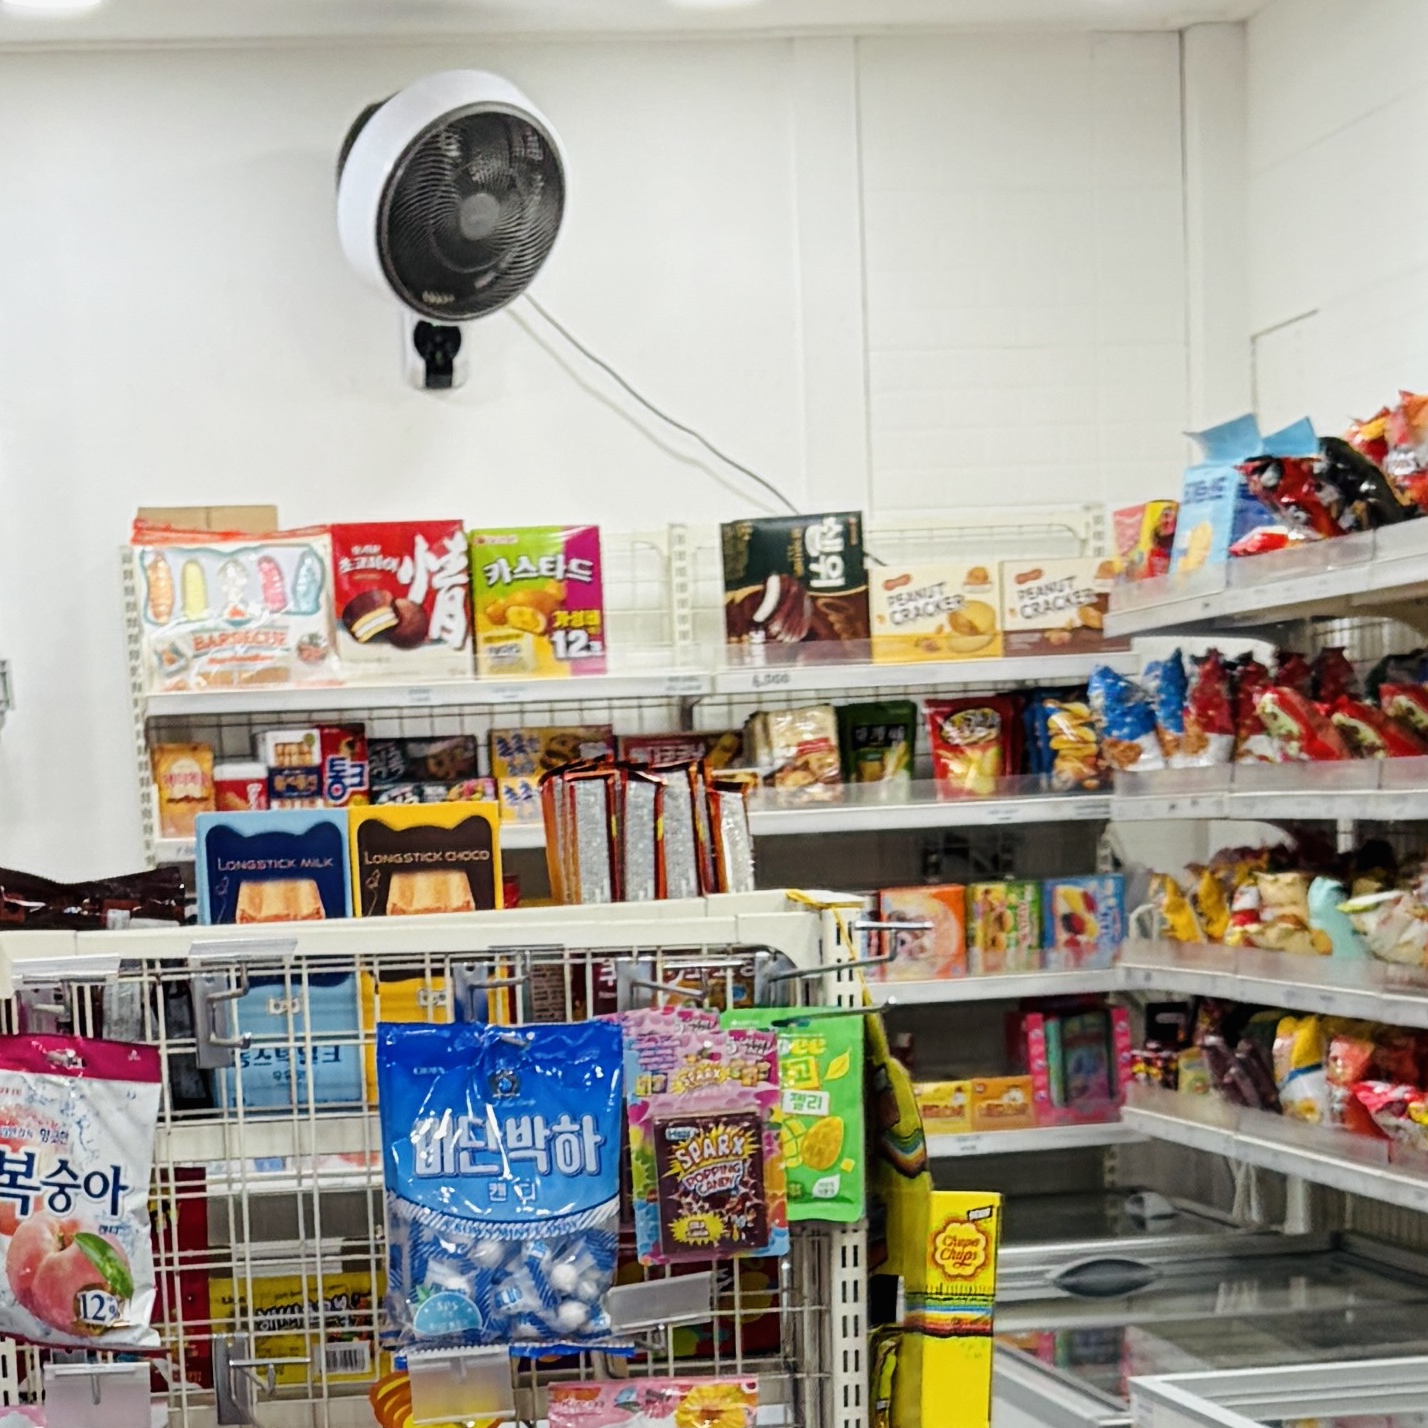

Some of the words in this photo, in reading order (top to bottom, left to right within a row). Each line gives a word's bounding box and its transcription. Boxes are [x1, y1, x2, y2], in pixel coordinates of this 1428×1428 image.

[483, 554, 594, 586] 카스타드
[887, 582, 947, 609] PEANUT
[1017, 577, 1077, 604] PEANUT
[889, 595, 966, 626] CRACKER
[1020, 591, 1098, 620] CRACKER
[217, 856, 298, 873] LONGSTICK
[300, 855, 335, 870] MILK
[364, 850, 442, 868] LONGSTICK
[443, 848, 491, 864] CHOCO
[675, 1134, 745, 1170] SPARX
[684, 1163, 742, 1187] POPPING
[695, 1175, 739, 1197] CANDY
